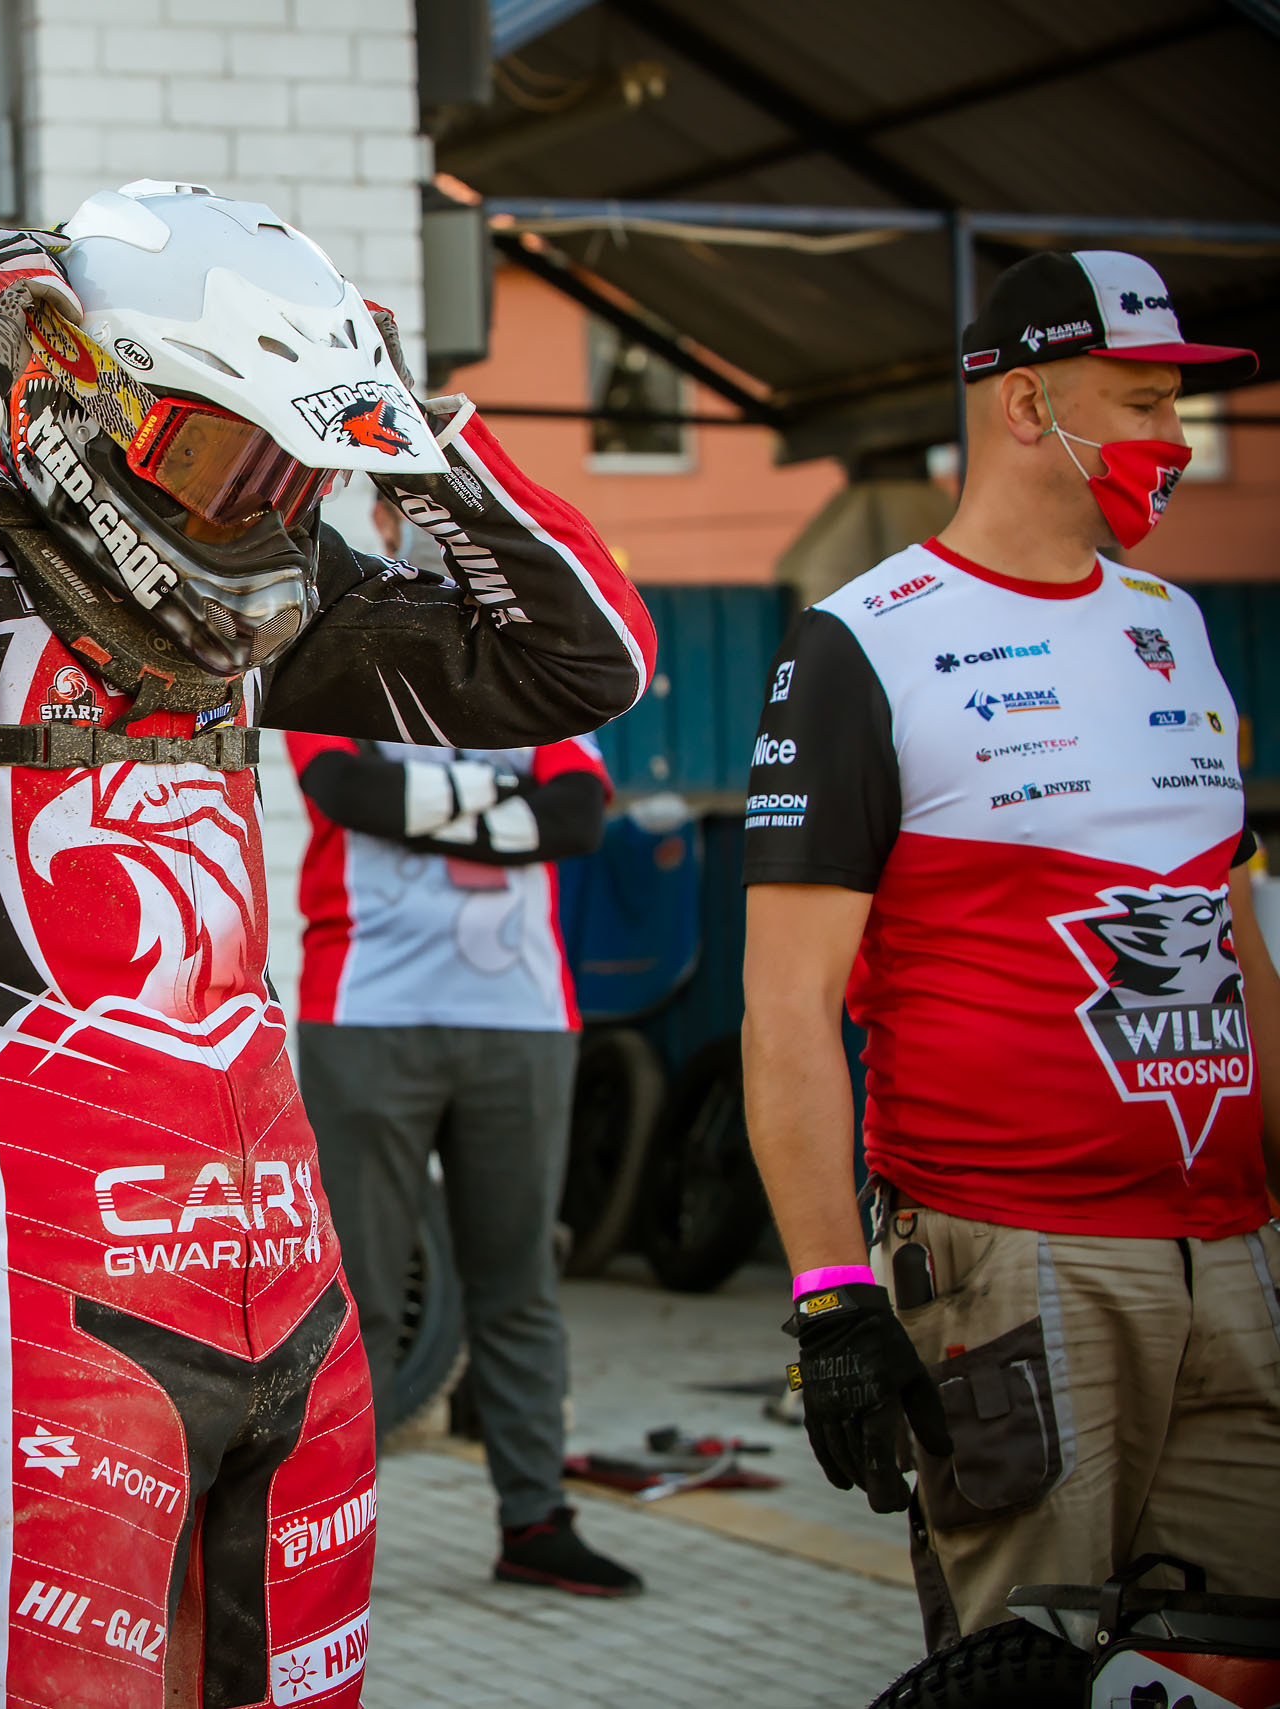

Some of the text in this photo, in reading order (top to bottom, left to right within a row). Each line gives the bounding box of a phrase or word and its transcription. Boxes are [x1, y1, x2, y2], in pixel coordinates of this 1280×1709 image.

[1046, 320, 1091, 336] MARMA
[116, 343, 151, 366] Arai
[134, 414, 157, 450] OAKLEY
[27, 405, 179, 610] MAD-CROC
[963, 640, 1052, 664] cellfast
[1001, 690, 1058, 702] MARMA
[40, 703, 105, 722] START
[751, 733, 797, 767] Nice
[994, 739, 1077, 757] INWENTECH
[1191, 757, 1225, 770] TEAM
[991, 779, 1092, 808] PRO INVEST
[1152, 775, 1199, 789] VADIM
[1116, 1009, 1245, 1055] WILKI
[1137, 1057, 1244, 1087] KROSNO
[104, 1236, 302, 1278] GWARANT
[91, 1455, 181, 1514] AFORTI
[16, 1582, 166, 1663] HIL-GAZ
